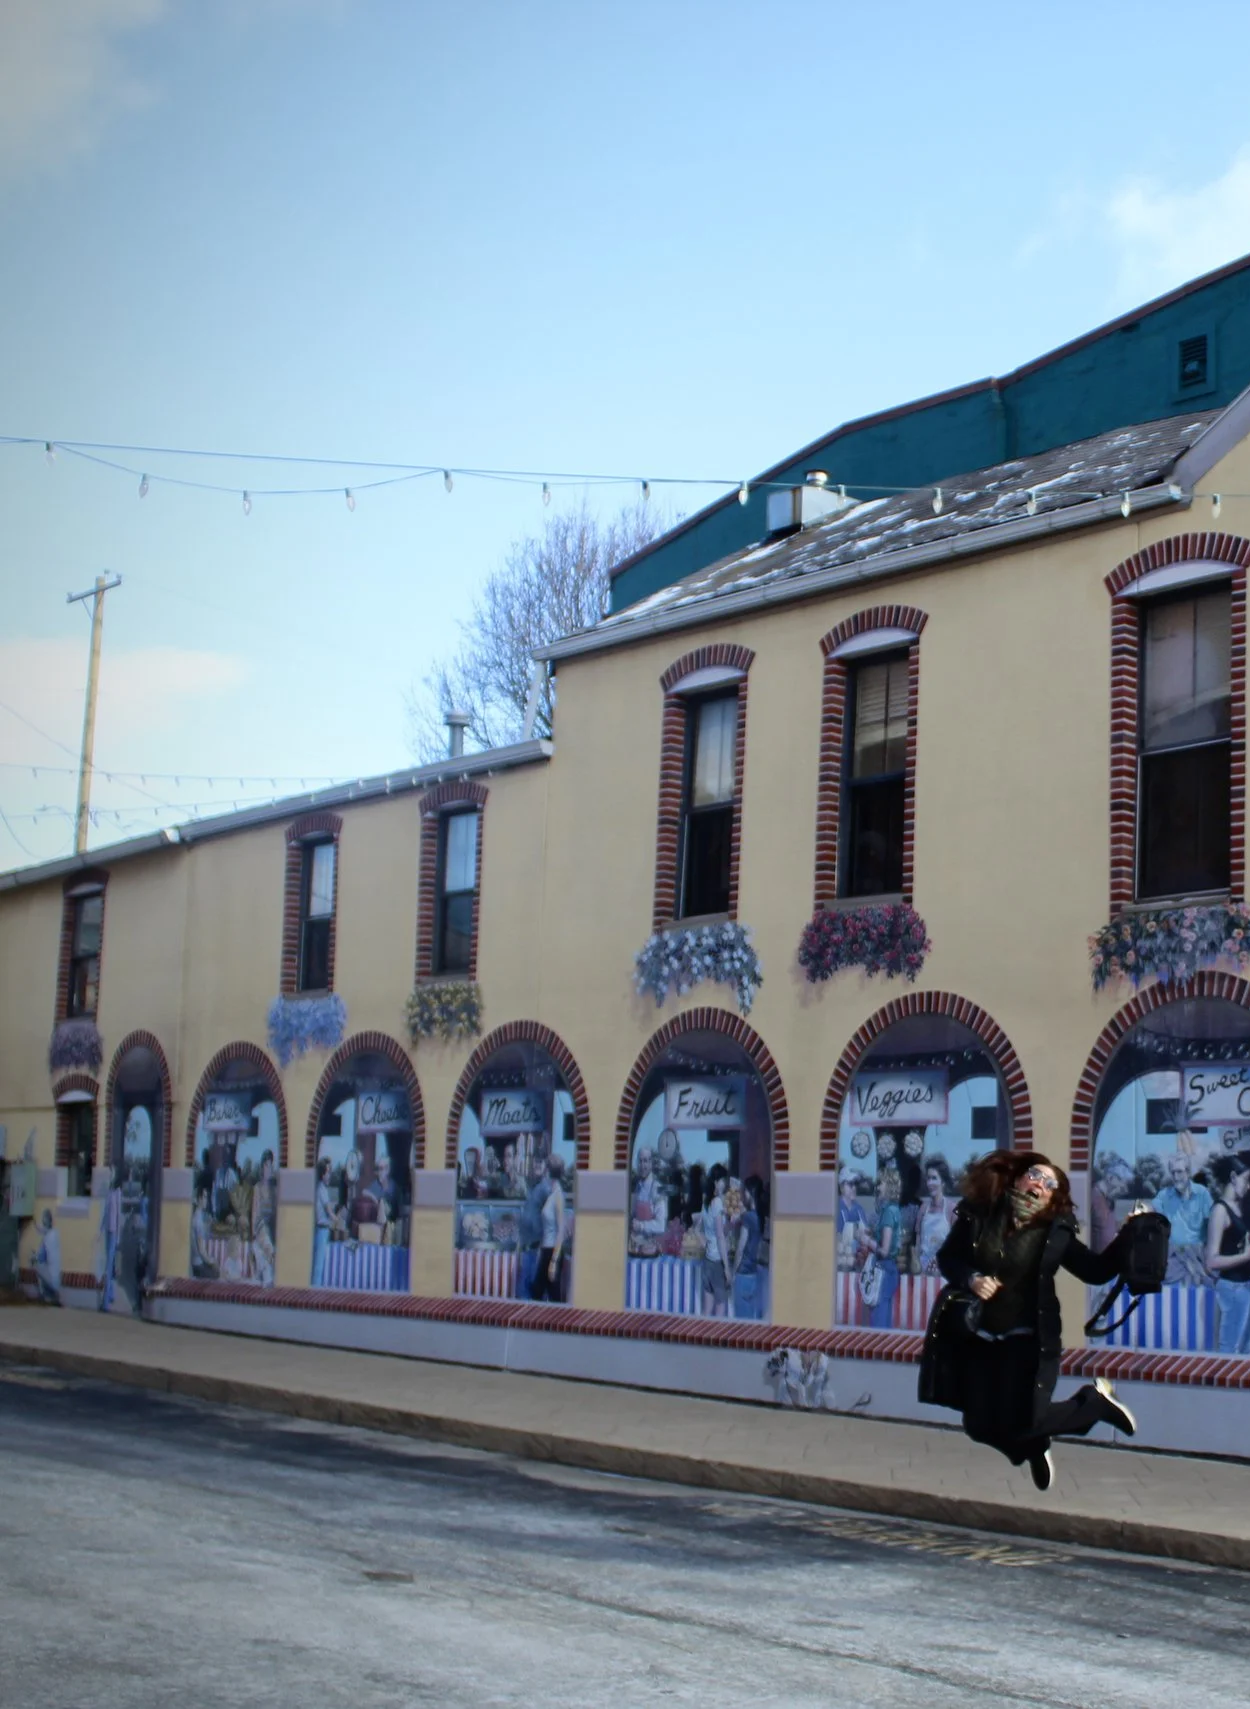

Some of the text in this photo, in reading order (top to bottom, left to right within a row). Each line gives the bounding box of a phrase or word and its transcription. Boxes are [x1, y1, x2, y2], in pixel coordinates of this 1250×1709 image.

[673, 1086, 737, 1119] Fruit
[857, 1081, 933, 1118] Veggies
[1189, 1067, 1250, 1105] Sweet
[361, 1095, 408, 1125] Cheese
[484, 1096, 541, 1127] Meats
